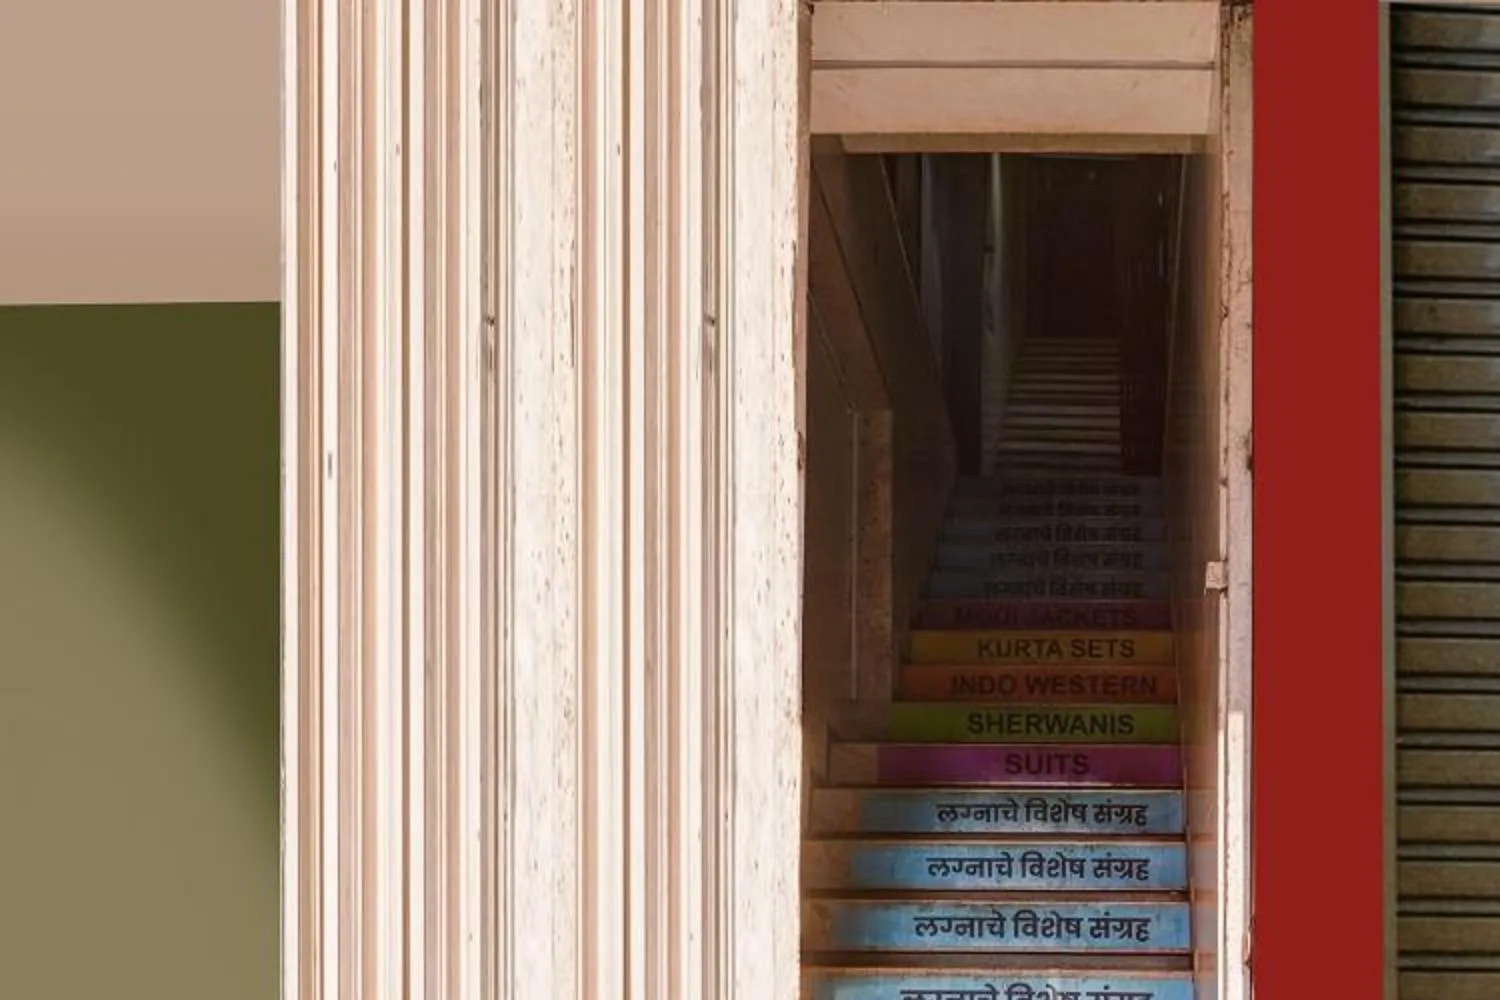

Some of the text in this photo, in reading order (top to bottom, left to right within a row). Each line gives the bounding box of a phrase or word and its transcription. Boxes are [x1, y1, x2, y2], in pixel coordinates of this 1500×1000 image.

[977, 638, 1136, 659] KURTA SETS
[952, 675, 1159, 696] INDO WESTERN
[967, 713, 1135, 735] SHERWANIS
[1004, 753, 1091, 776] SUITS
[936, 797, 1148, 826] लग्नाचे विशेष संग्रह
[926, 850, 1151, 880] लग्नाचे विशेष संग्रह
[913, 909, 1152, 942] लग्नाचे विशेष संग्रह
